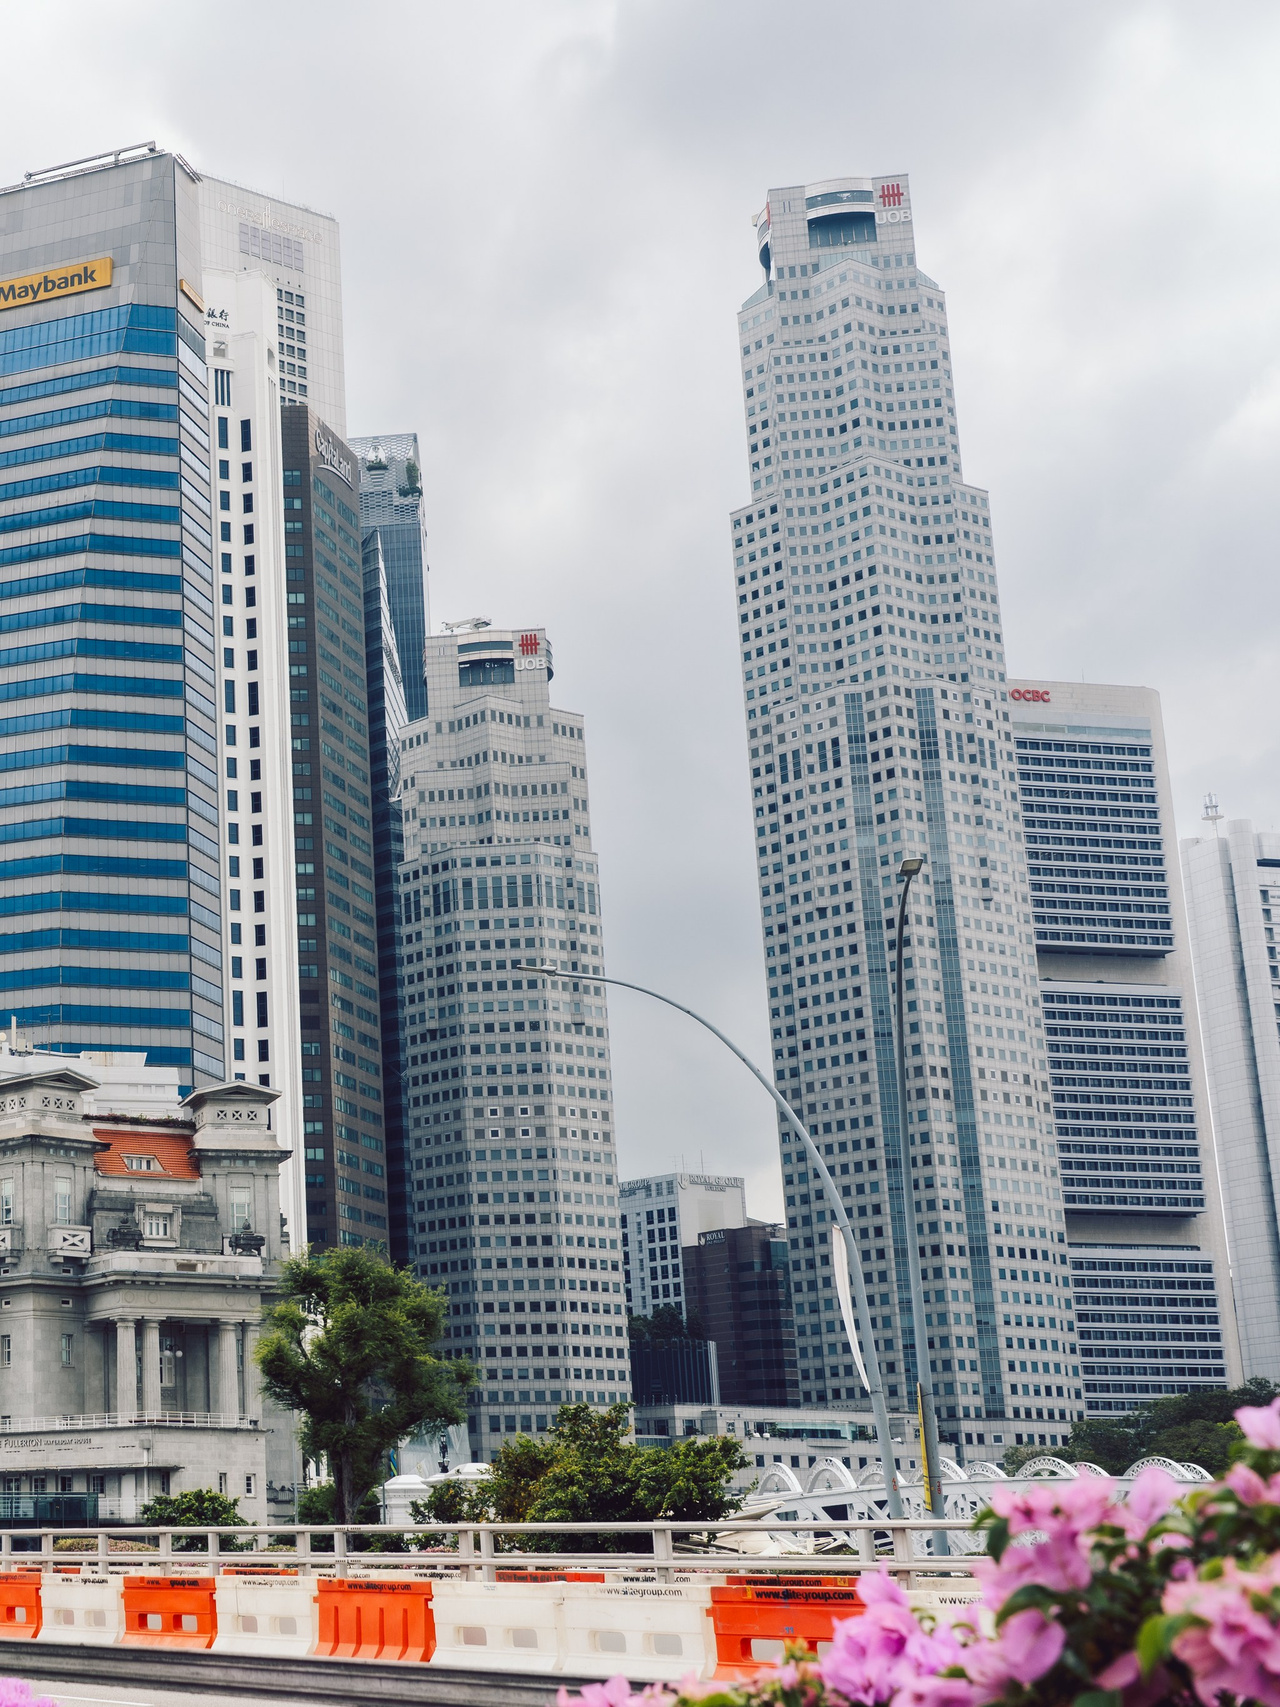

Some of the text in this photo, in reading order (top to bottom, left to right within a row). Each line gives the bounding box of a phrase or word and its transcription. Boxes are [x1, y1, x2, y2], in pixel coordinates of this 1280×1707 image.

[875, 209, 911, 225] UOB
[211, 321, 230, 329] CHINA
[515, 658, 547, 671] UOB
[1011, 688, 1051, 703] OCBC
[755, 1589, 855, 1602] www.slitegroup.com
